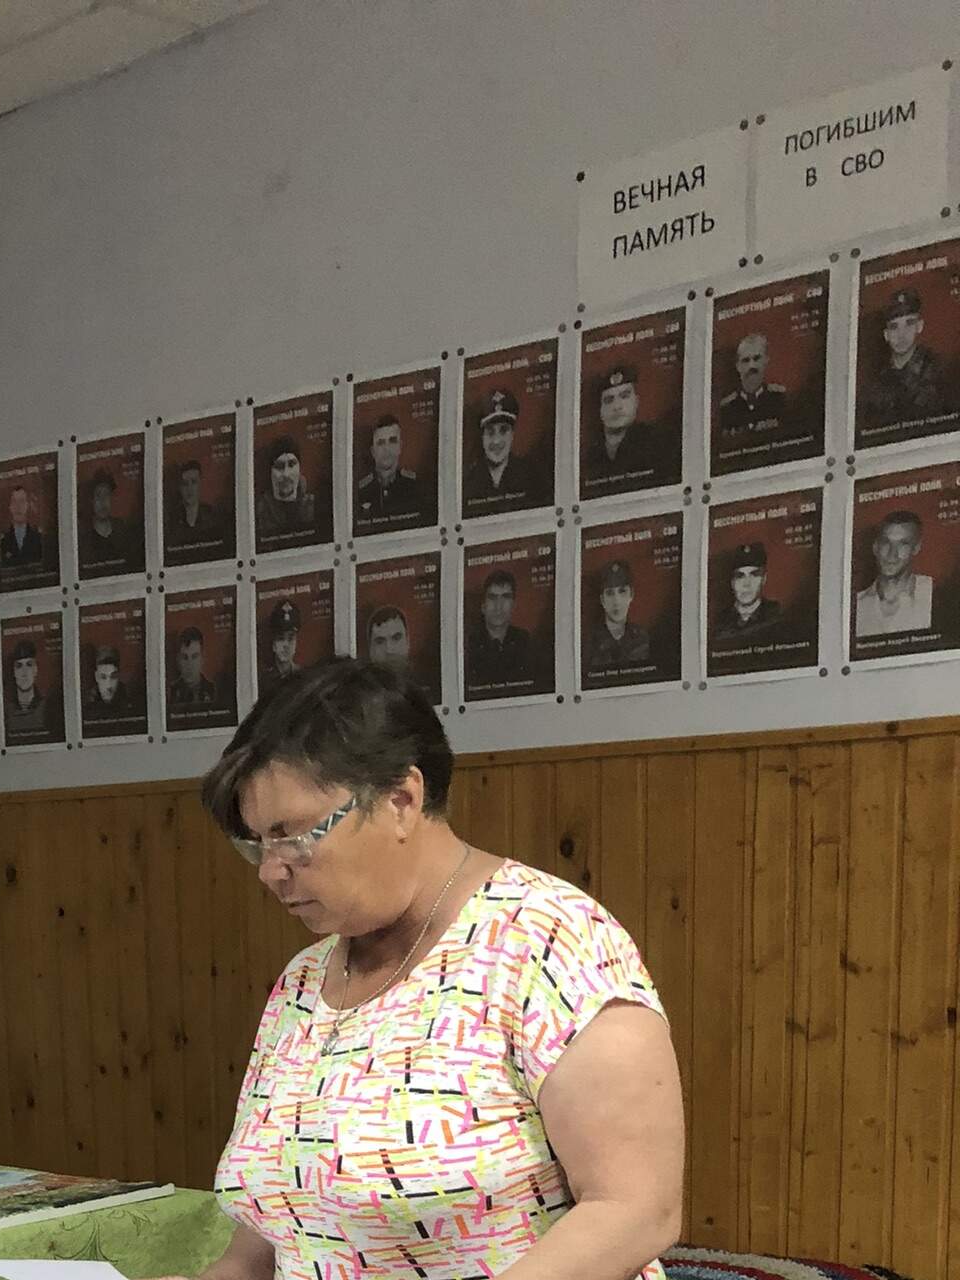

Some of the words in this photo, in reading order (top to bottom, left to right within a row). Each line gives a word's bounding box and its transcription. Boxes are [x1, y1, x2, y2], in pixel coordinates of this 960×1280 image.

[784, 100, 916, 155] ПОГИБШИМ
[613, 164, 706, 214] ВЕЧНАЯ
[805, 167, 817, 188] В
[841, 149, 884, 178] СВО
[612, 209, 715, 259] ПАМЯТЬ
